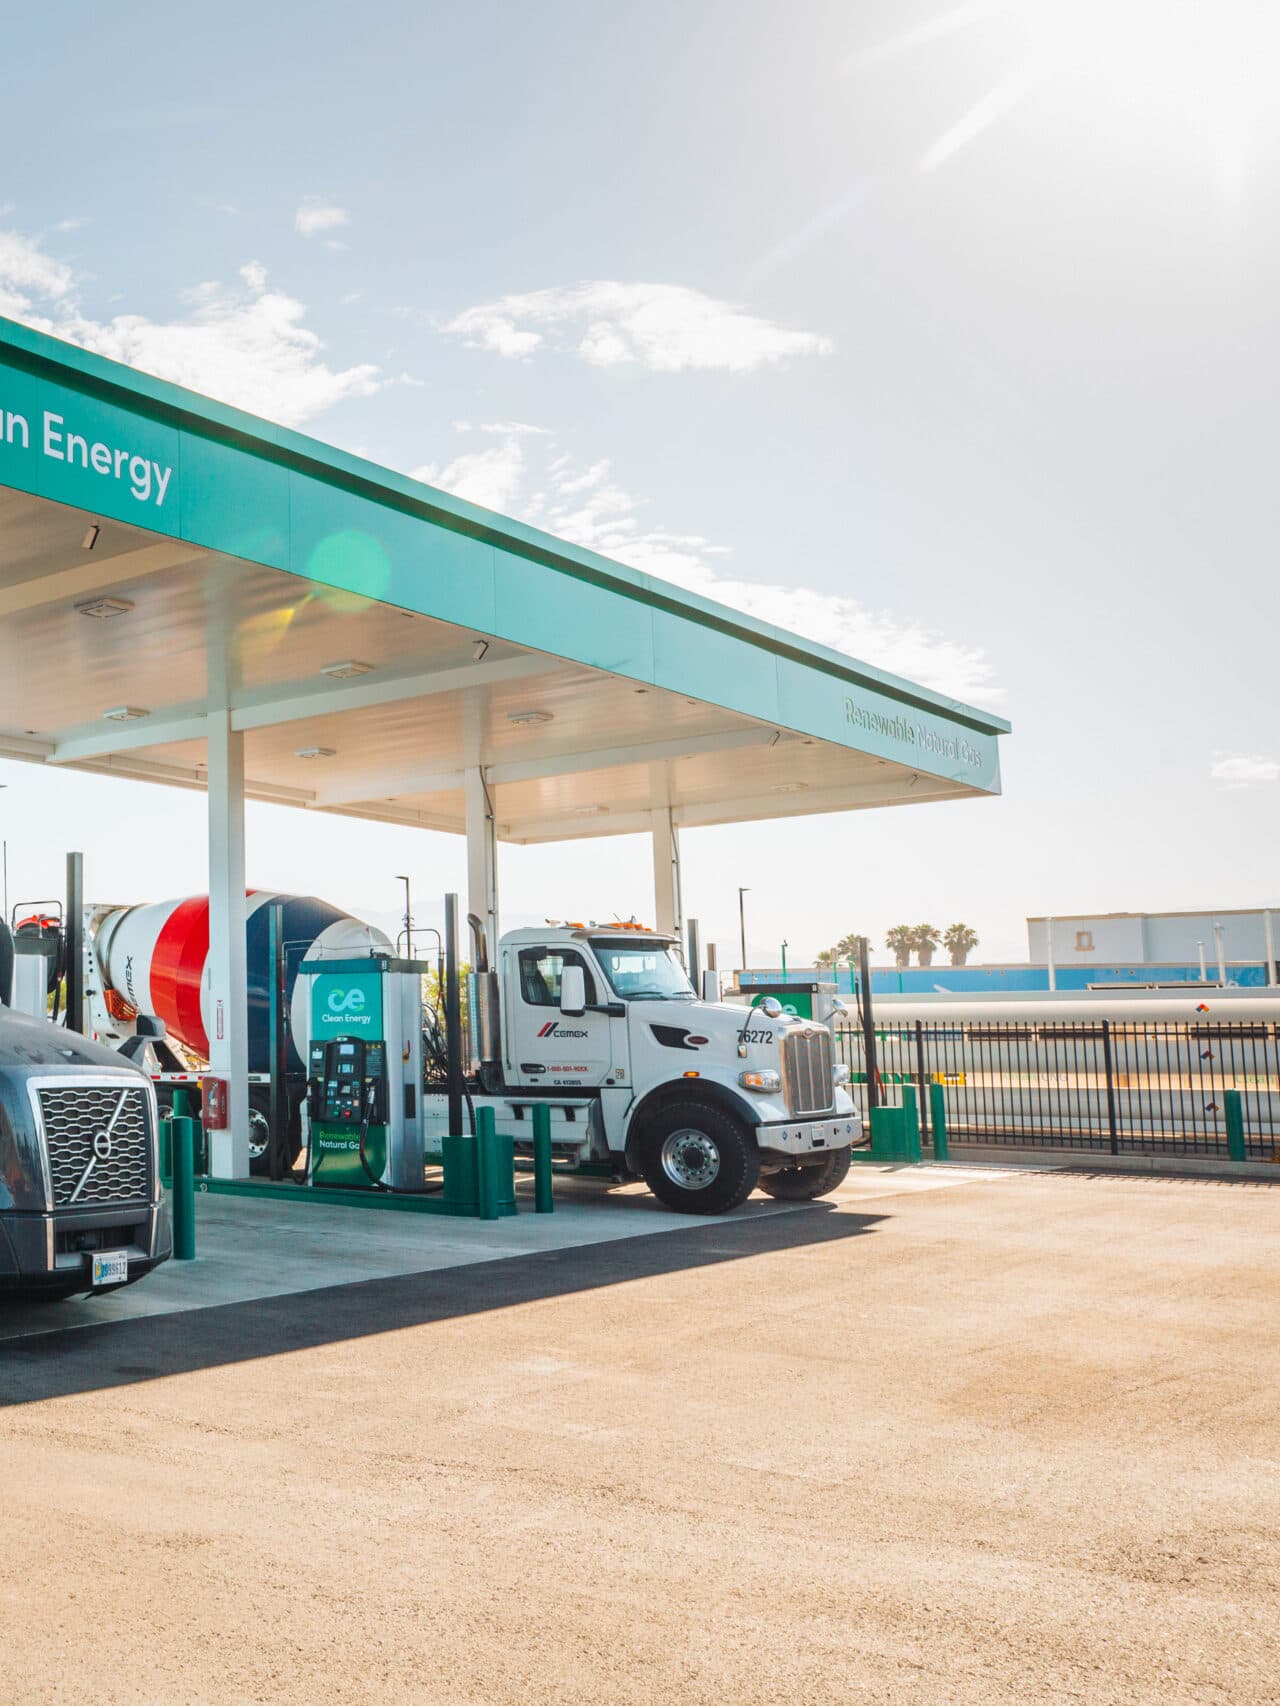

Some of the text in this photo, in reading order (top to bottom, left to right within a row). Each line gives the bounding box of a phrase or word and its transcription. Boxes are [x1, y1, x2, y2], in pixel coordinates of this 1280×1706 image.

[43, 411, 173, 507] Energy
[844, 697, 915, 745] Renewable
[918, 725, 959, 760] Natural
[322, 1014, 371, 1024] Clean Energy
[553, 1030, 588, 1038] CEMEX
[736, 1029, 773, 1044] 76272
[320, 1140, 361, 1149] Natural Ga
